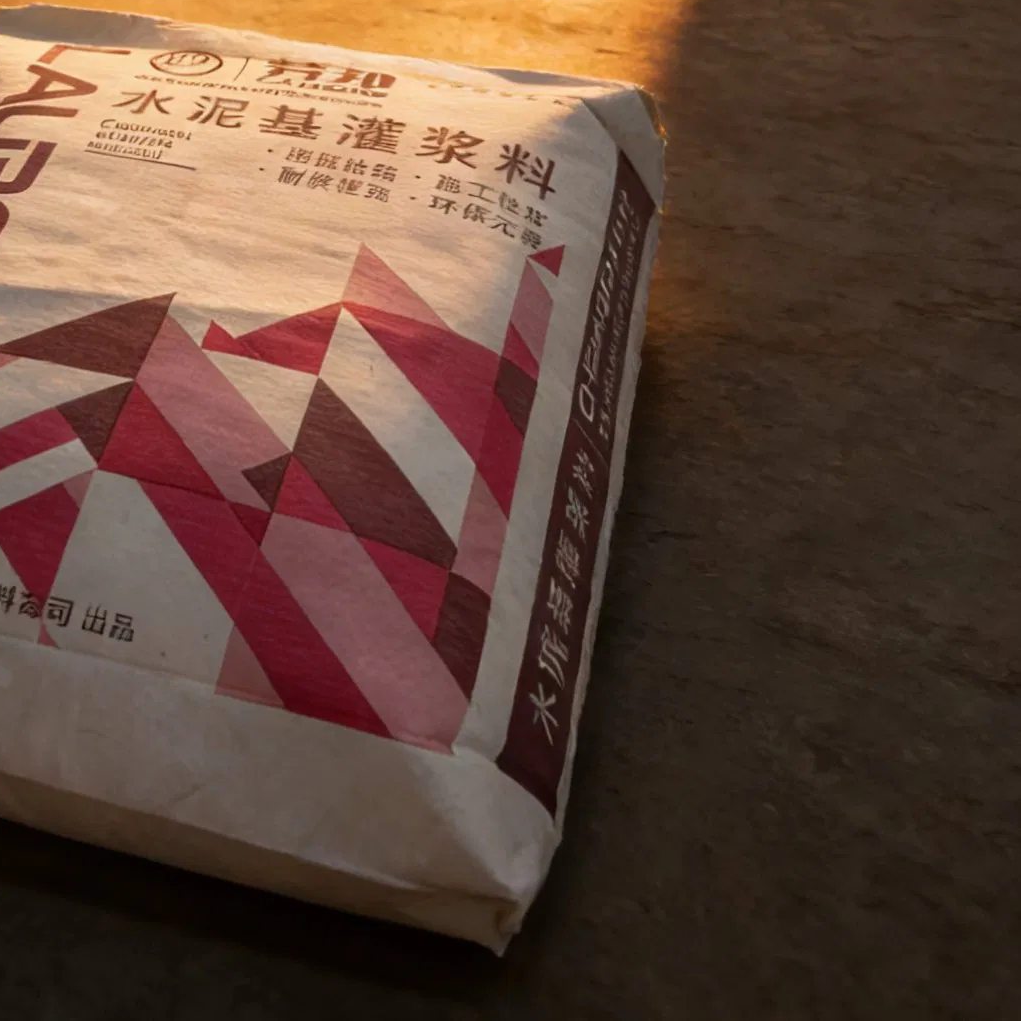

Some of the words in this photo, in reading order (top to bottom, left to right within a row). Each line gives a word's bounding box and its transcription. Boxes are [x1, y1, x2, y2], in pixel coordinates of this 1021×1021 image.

[111, 88, 557, 201] 水泥基灌浆料
[81, 604, 135, 643] 出品
